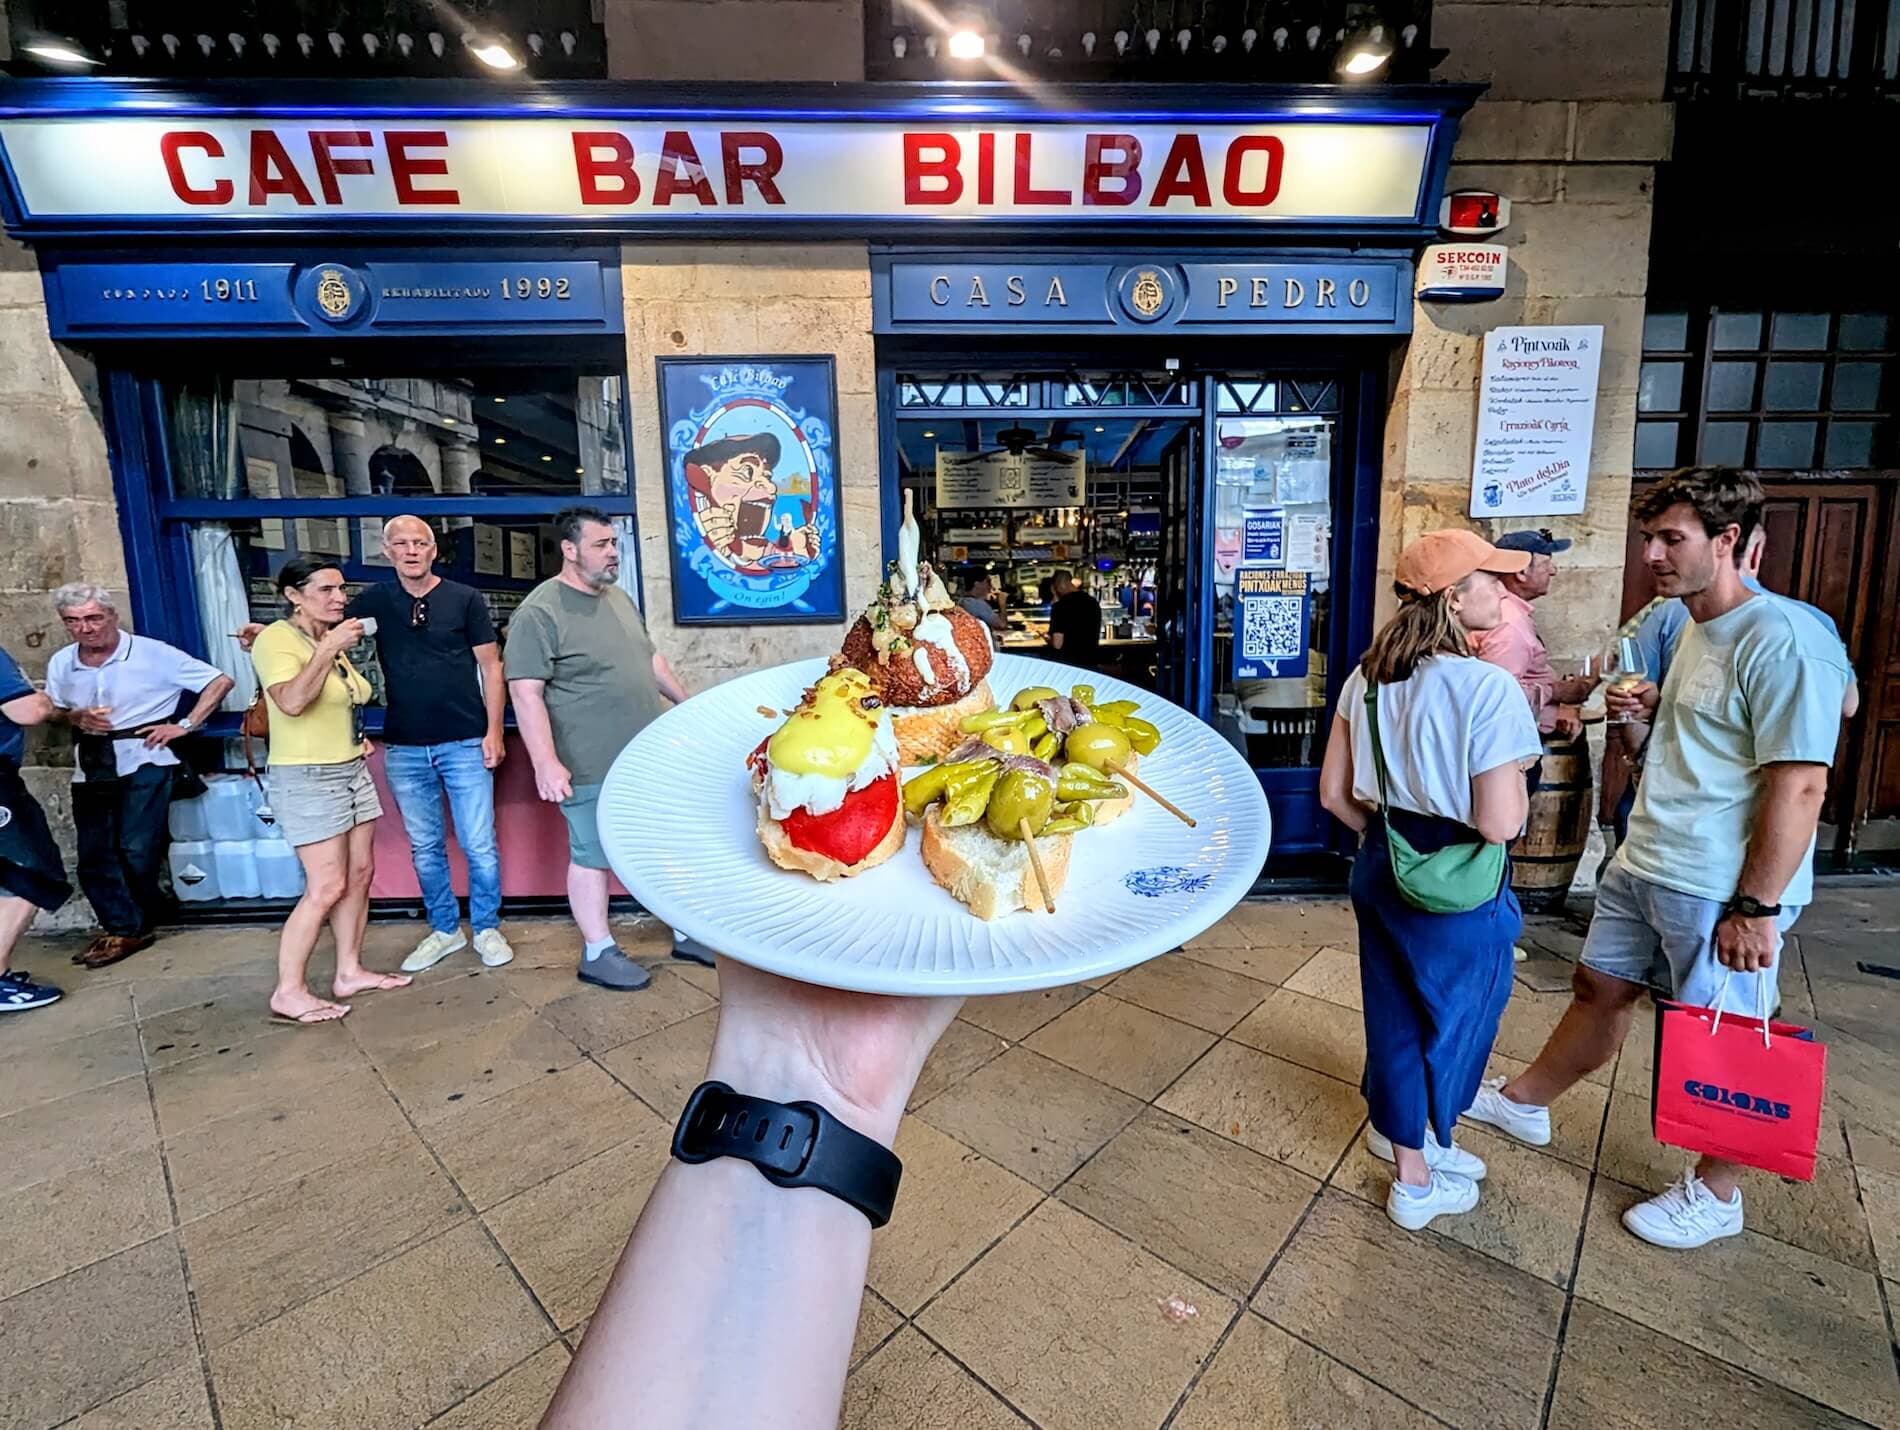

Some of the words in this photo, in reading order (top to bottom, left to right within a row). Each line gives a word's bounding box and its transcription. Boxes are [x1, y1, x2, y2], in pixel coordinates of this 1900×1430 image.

[160, 130, 461, 206] CAFE
[571, 130, 787, 206] BAR
[902, 131, 1286, 208] BILBAO
[1436, 251, 1502, 265] SERCOIN
[200, 278, 260, 302] 1911
[500, 277, 572, 300] 1992
[930, 275, 1069, 309] CASA
[1217, 277, 1372, 309] PEDRO
[733, 592, 752, 603] On
[1239, 579, 1282, 593] PINTXOAK
